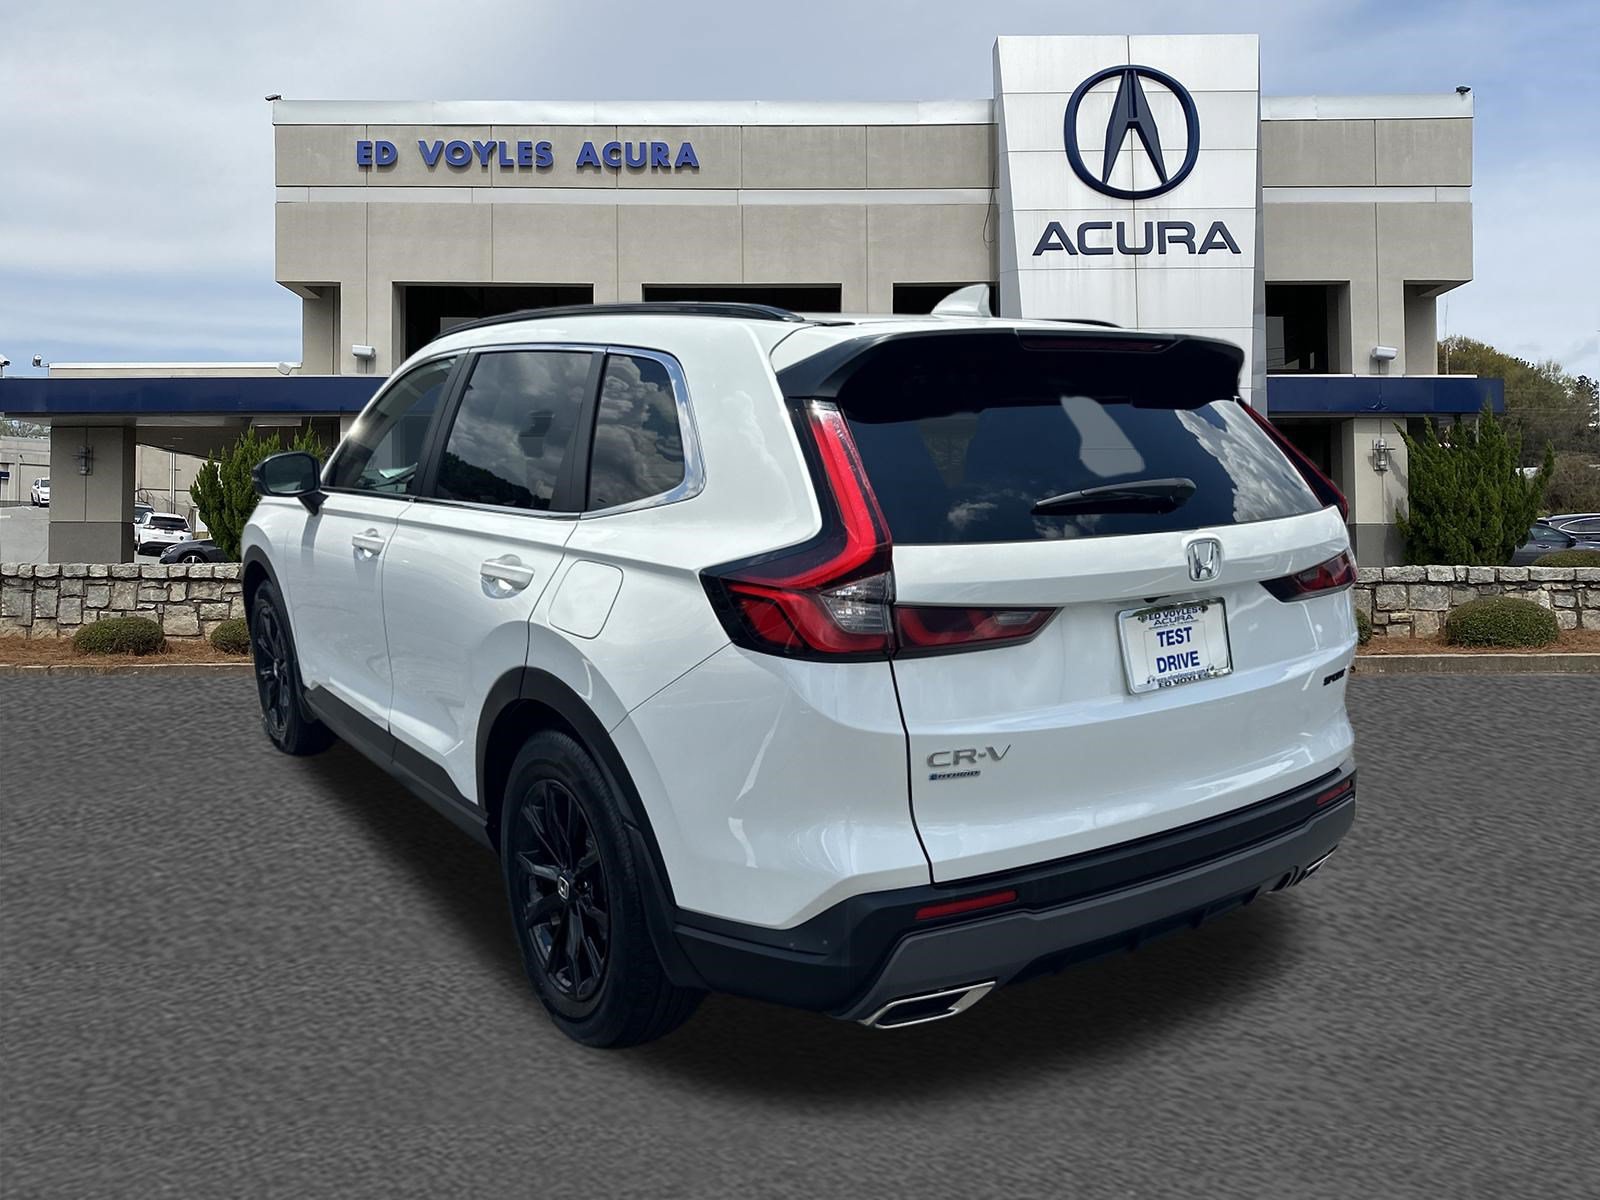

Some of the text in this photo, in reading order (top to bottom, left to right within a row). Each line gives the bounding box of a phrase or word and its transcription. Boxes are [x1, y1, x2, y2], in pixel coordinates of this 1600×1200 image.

[356, 140, 701, 168] ED VOYLES ACURA
[1032, 221, 1242, 256] ACURA
[1153, 615, 1194, 626] ACURA
[1157, 626, 1192, 647] TEST
[1156, 651, 1200, 673] DRIVE
[927, 744, 1011, 767] CR-V
